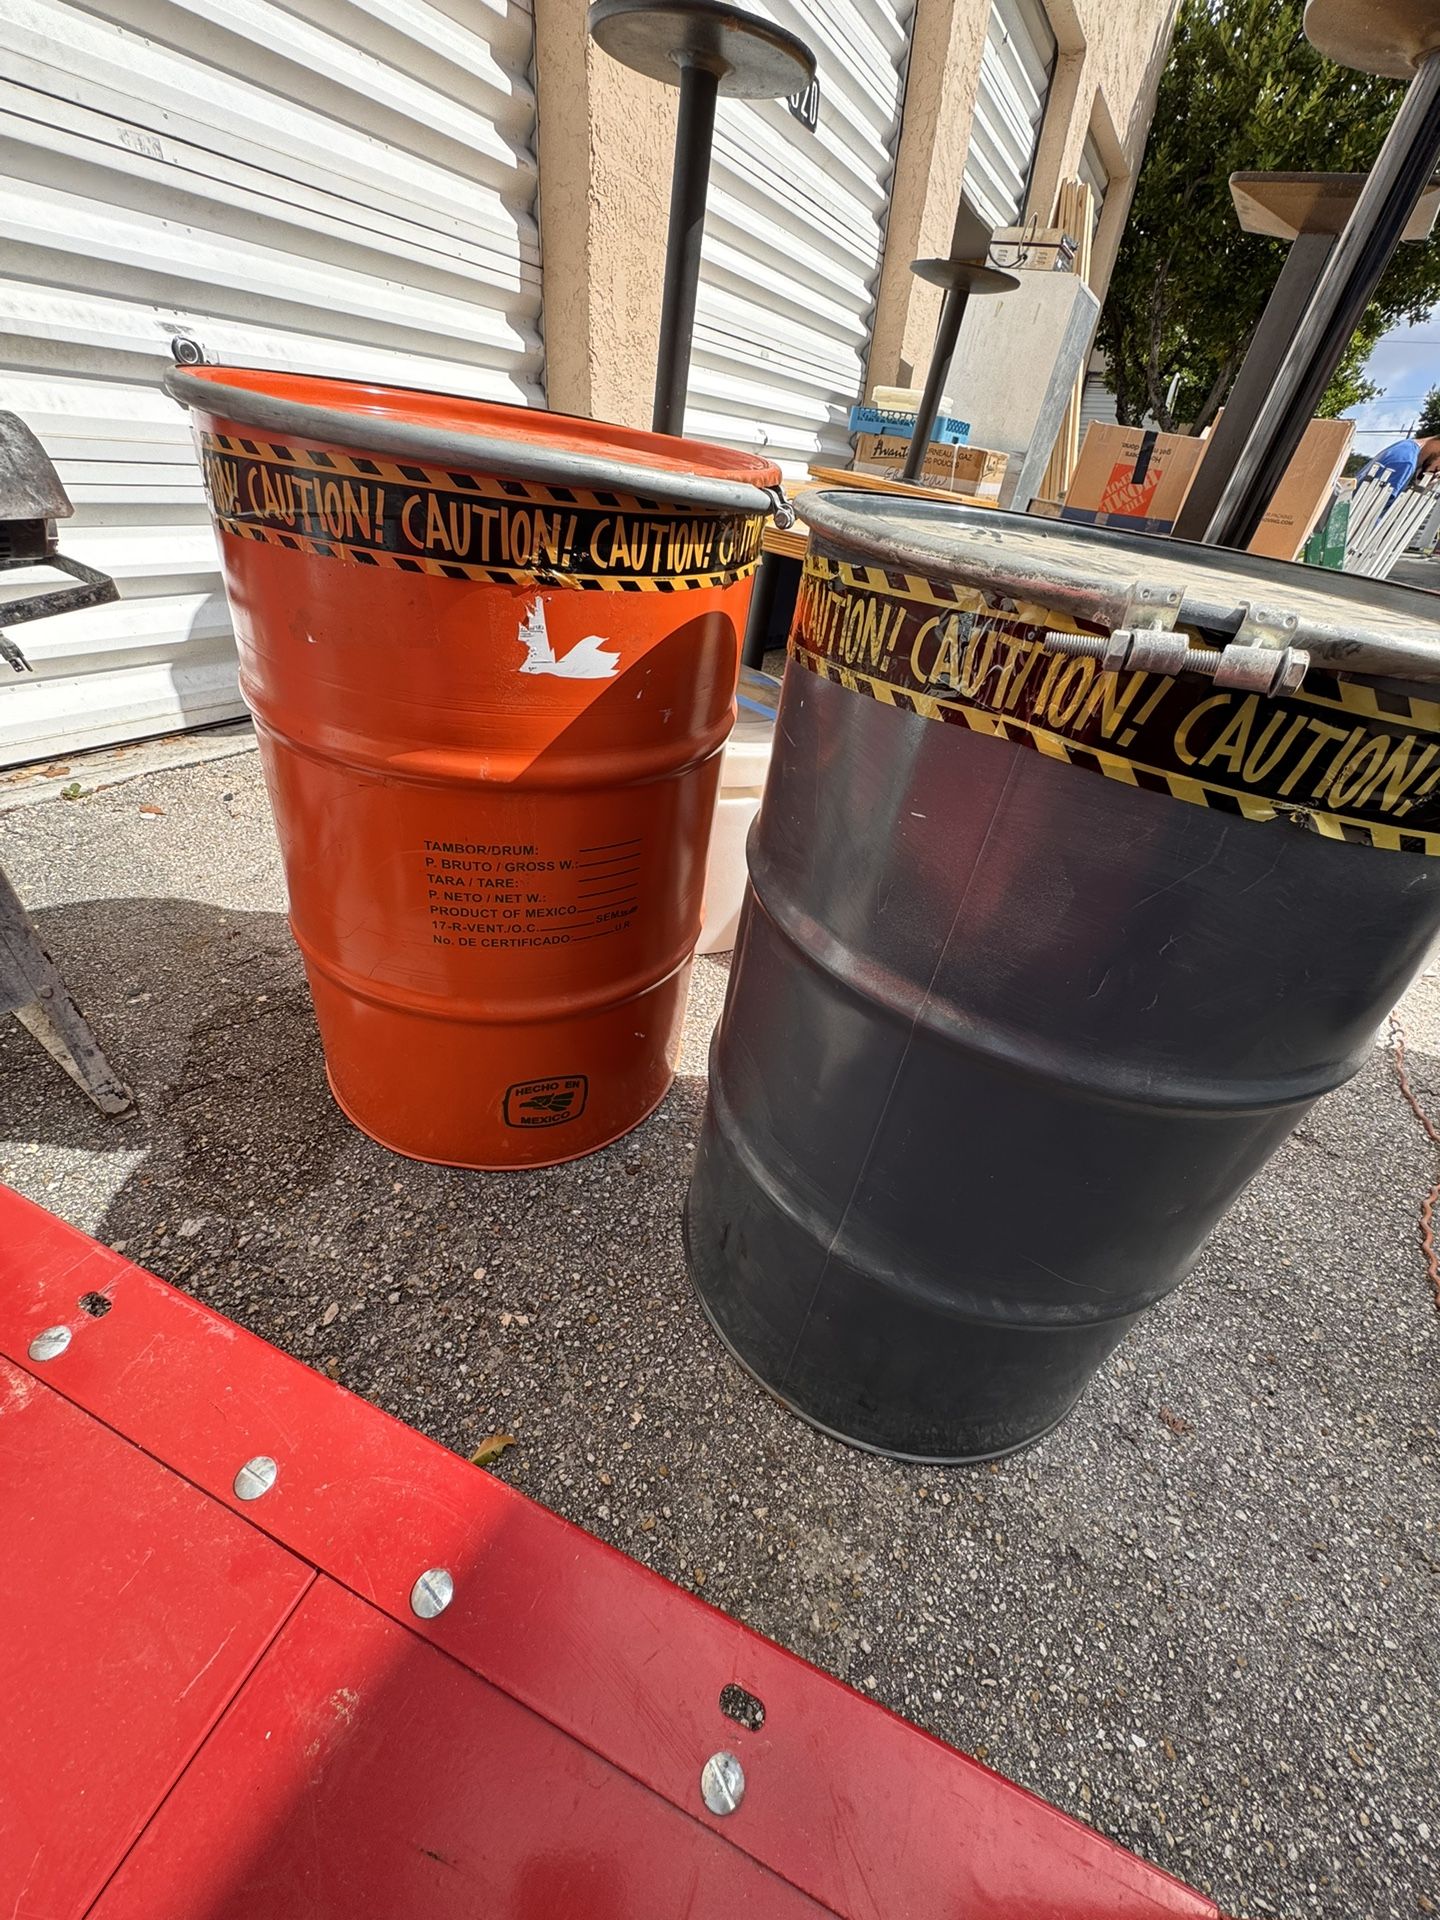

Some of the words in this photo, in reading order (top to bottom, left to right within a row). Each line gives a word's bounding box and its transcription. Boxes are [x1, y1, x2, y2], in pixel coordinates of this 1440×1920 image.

[933, 457, 960, 469] POUCS
[247, 463, 385, 544] CAUTION!
[401, 492, 578, 568] CAUTION!
[589, 515, 717, 574] CAUTION!
[801, 581, 908, 673] CAUTION!
[1173, 693, 1440, 818] CAUTION!
[423, 840, 539, 856] TAMBOR/DRUM:
[425, 857, 437, 868] P.
[441, 858, 493, 873] BRUTO
[504, 861, 556, 873] GROSS
[426, 874, 465, 887] TARA
[477, 878, 519, 888] TARE:
[428, 889, 440, 899] P.
[443, 891, 483, 903] NETO
[494, 893, 522, 904] NET
[429, 905, 498, 919] PRODUCT
[502, 909, 521, 919] OF
[525, 905, 577, 919] MEXICO
[433, 935, 455, 945] No.
[458, 937, 478, 947] DE
[515, 1081, 560, 1097] HECHO
[564, 1080, 580, 1089] EN
[520, 1110, 571, 1125] MEXICO
